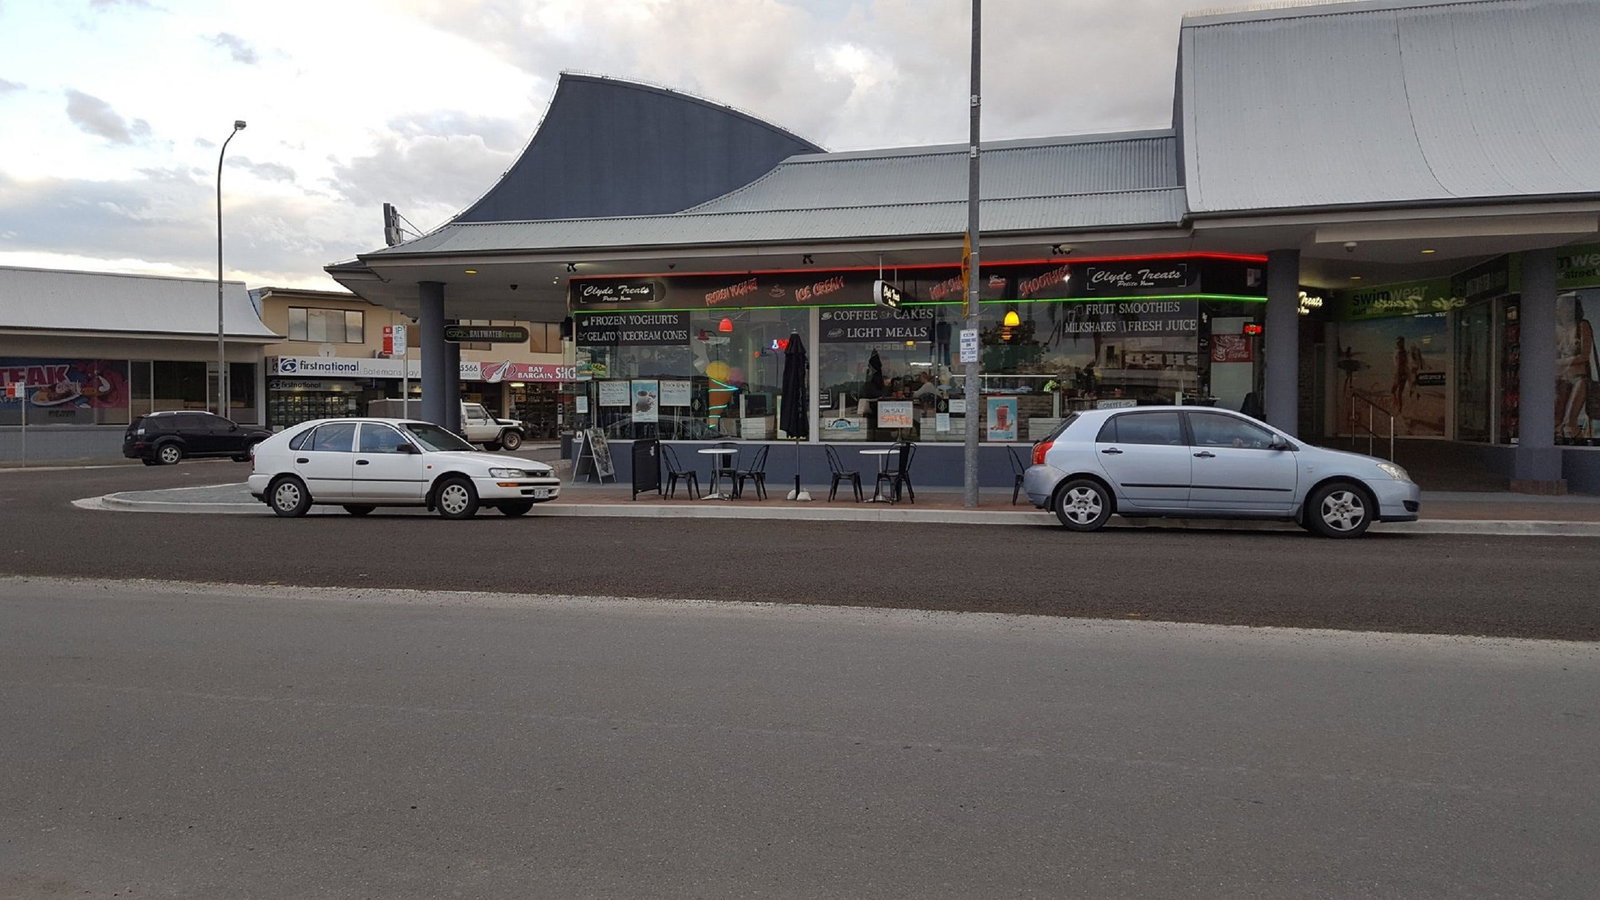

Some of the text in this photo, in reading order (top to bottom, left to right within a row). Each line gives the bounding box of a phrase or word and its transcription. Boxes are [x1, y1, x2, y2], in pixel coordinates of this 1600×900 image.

[1092, 270, 1133, 283] Clyde
[1138, 268, 1182, 279] Treats
[584, 285, 650, 296] Clyde Treats
[1352, 286, 1428, 307] swimwear
[1086, 301, 1180, 314] FRUIT SMOOTHIES
[590, 315, 679, 326] FROZEN YOGHURTS
[833, 309, 934, 320] COFFEE CAKES
[847, 326, 928, 338] LIGHT MEALS
[1065, 319, 1197, 333] MILKSHAKES FRESH JUICE
[587, 330, 688, 341] GELATO ICECREAM CONES
